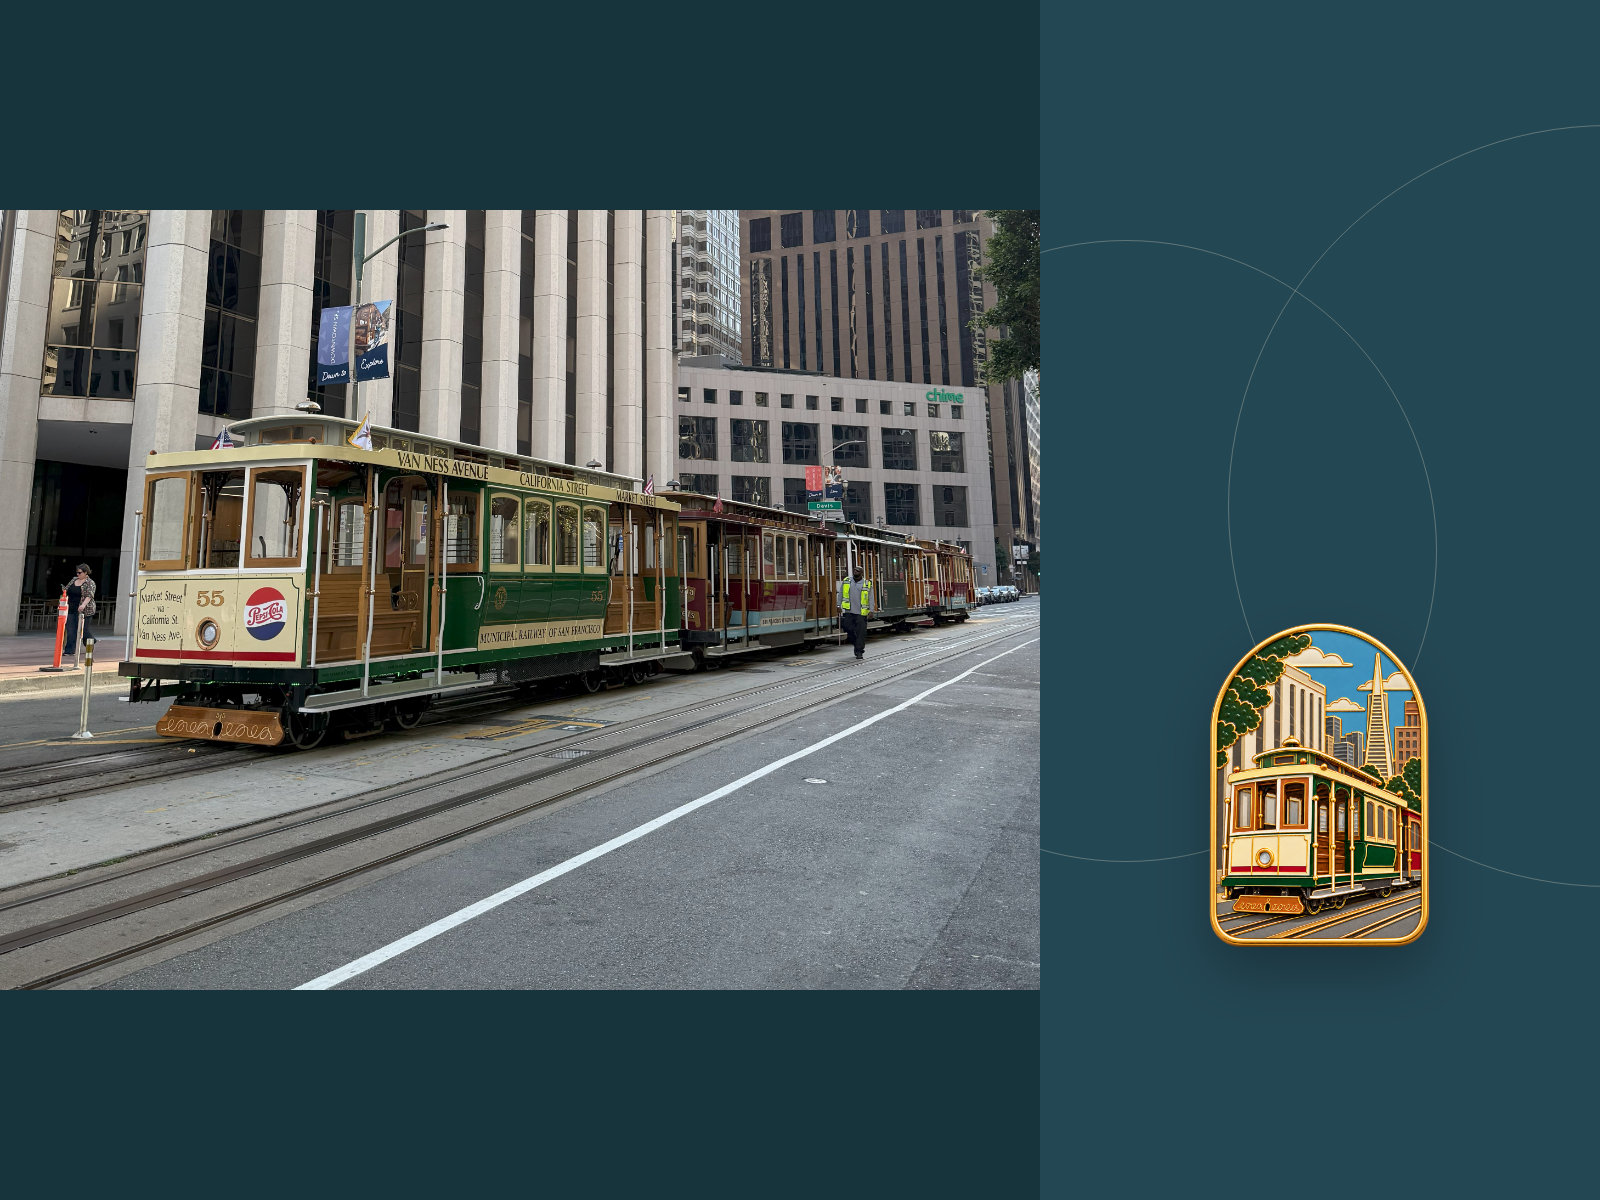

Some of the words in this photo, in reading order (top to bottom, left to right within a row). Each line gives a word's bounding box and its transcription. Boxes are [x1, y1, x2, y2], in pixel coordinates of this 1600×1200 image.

[360, 358, 384, 371] Explore
[321, 371, 340, 382] Down
[926, 387, 965, 404] chime
[398, 451, 421, 468] VAN
[424, 456, 449, 474] NESS
[451, 461, 489, 480] AVENUE
[519, 472, 565, 492] CALIFORNIA
[566, 480, 589, 496] STREET
[615, 489, 639, 504] MARKET
[640, 493, 657, 507] STREET
[141, 591, 163, 604] Market
[164, 590, 183, 604] Street
[196, 589, 225, 608] 55
[590, 590, 605, 603] 55
[156, 605, 165, 613] via
[141, 615, 170, 625] California
[171, 614, 179, 625] St.
[138, 629, 150, 640] Van
[151, 631, 167, 642] Ness
[168, 631, 182, 640] Ave.
[479, 630, 517, 644] MUNICIPAL
[518, 628, 547, 641] RAILWAY
[548, 628, 557, 638] OF
[558, 627, 570, 637] SAN
[571, 624, 601, 636] FRANCISCO
